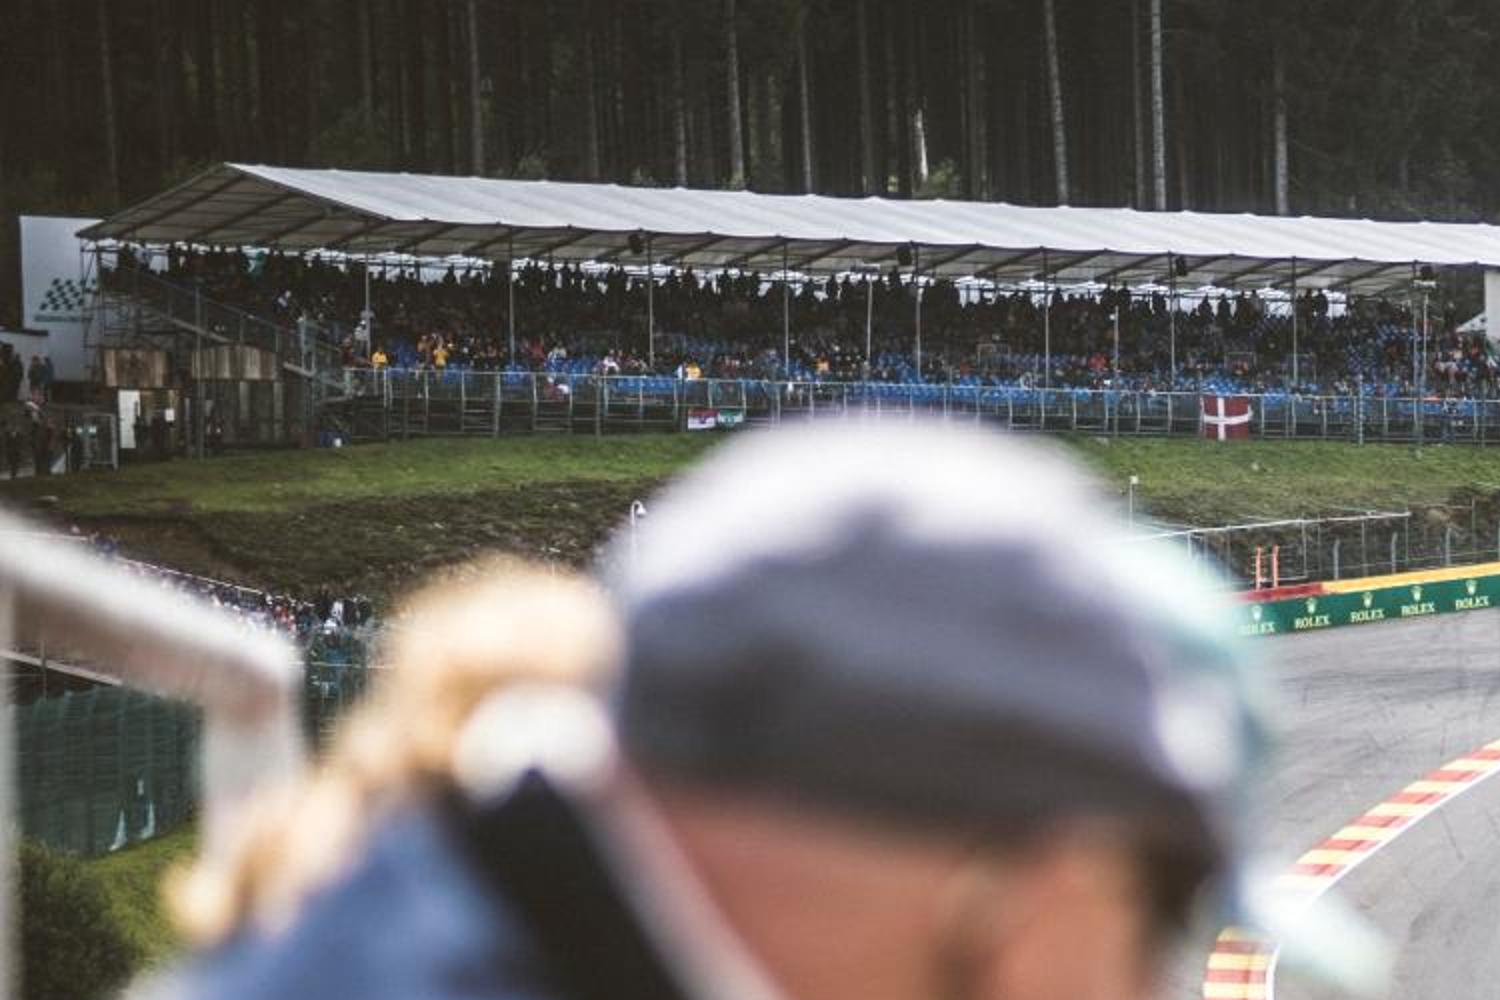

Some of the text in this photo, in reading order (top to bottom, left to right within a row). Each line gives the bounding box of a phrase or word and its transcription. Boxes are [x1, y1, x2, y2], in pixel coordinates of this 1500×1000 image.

[1400, 602, 1435, 616] ROLEX
[1455, 595, 1489, 610] ROLEX
[1294, 615, 1331, 629] ROLEX
[1350, 609, 1384, 623] ROLEX
